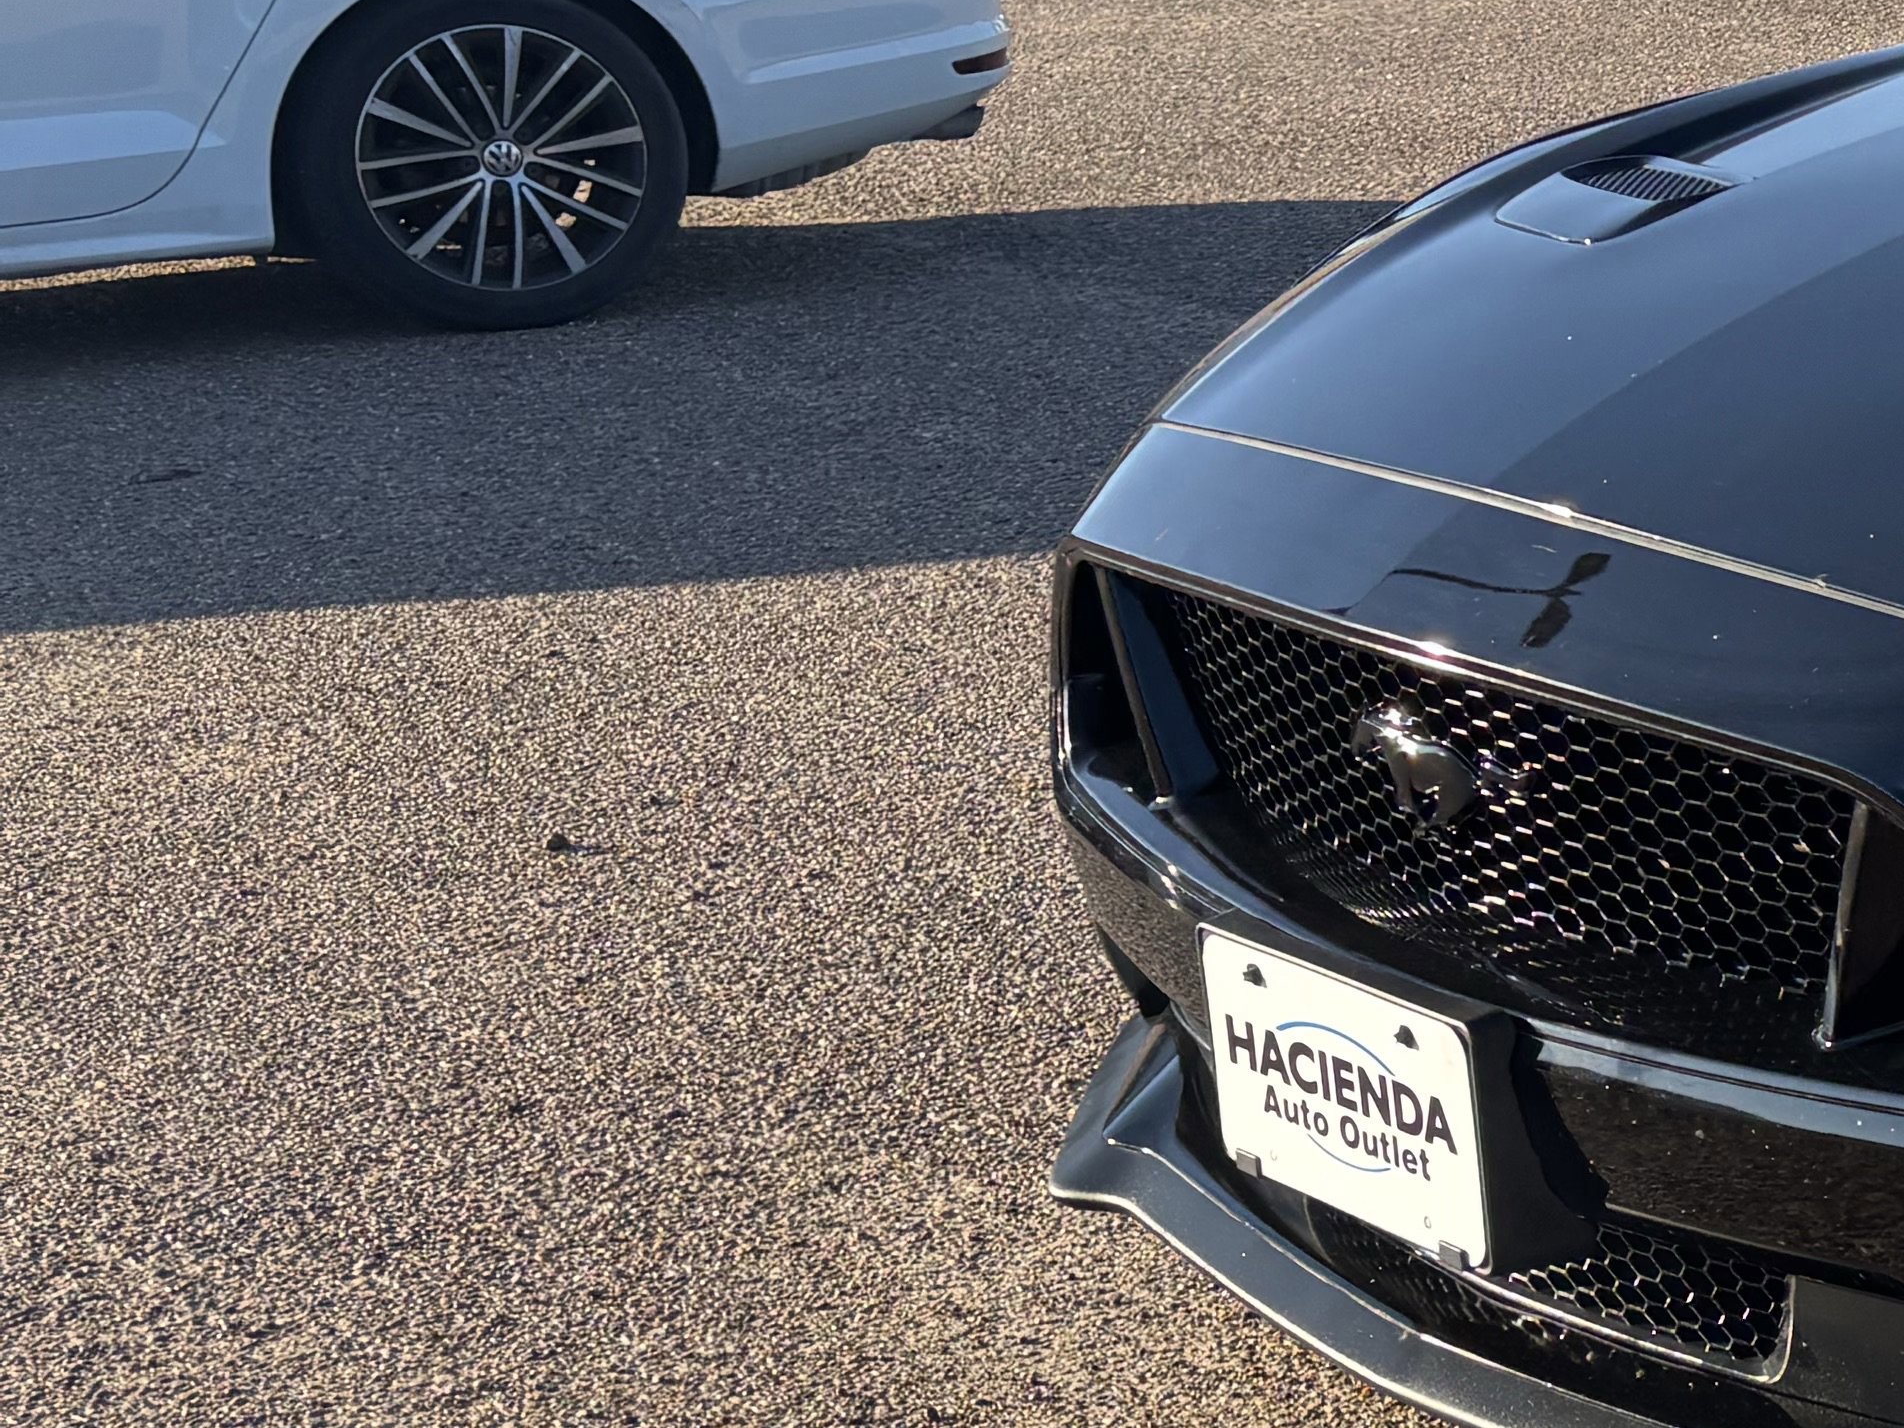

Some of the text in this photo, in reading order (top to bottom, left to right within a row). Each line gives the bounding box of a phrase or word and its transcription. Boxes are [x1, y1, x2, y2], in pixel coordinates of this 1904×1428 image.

[1224, 1013, 1458, 1156] HACIENDA
[1263, 1084, 1432, 1182] Auto Outlet
